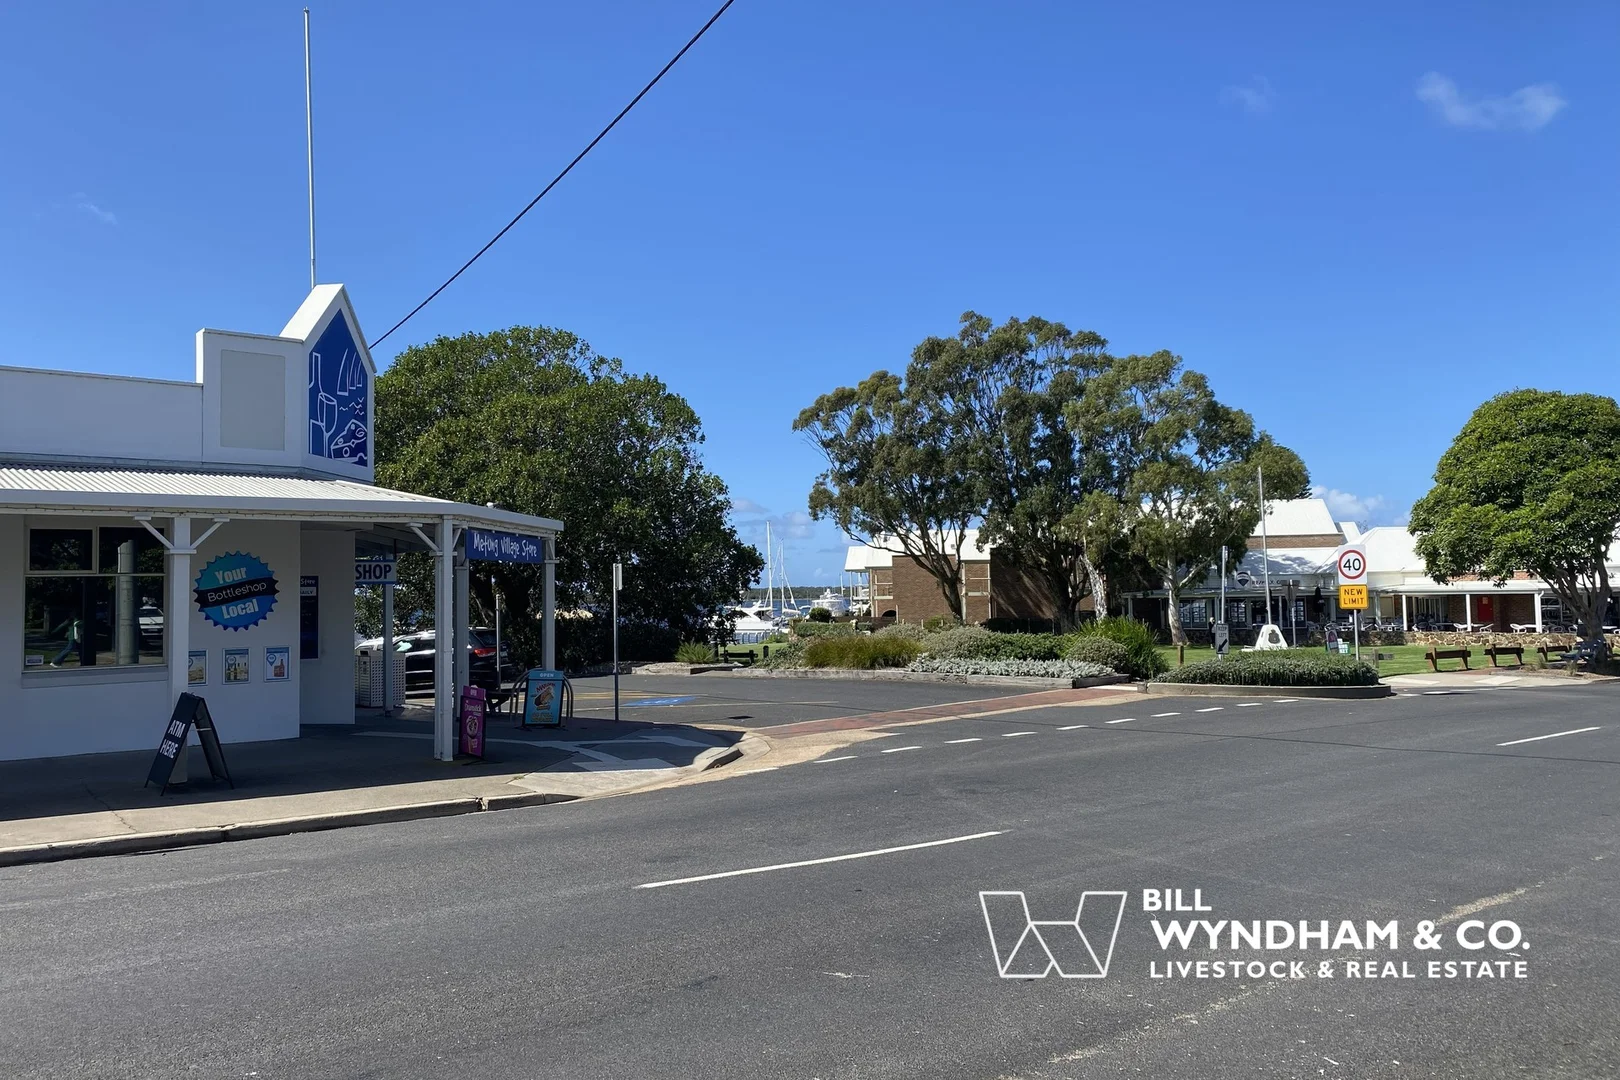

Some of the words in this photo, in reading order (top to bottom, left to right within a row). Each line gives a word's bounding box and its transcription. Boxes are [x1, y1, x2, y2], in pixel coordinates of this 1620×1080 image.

[473, 532, 499, 557] Metung
[500, 536, 520, 559] Village
[521, 539, 537, 561] Store
[355, 563, 392, 580] SHOP
[1343, 558, 1361, 571] 40
[214, 567, 247, 584] Your
[207, 582, 267, 603] Bottleshop
[1343, 597, 1365, 605] LIMIT
[1344, 588, 1363, 596] NEW
[221, 598, 259, 619] Local
[167, 719, 186, 738] ATM
[159, 738, 179, 759] HERE
